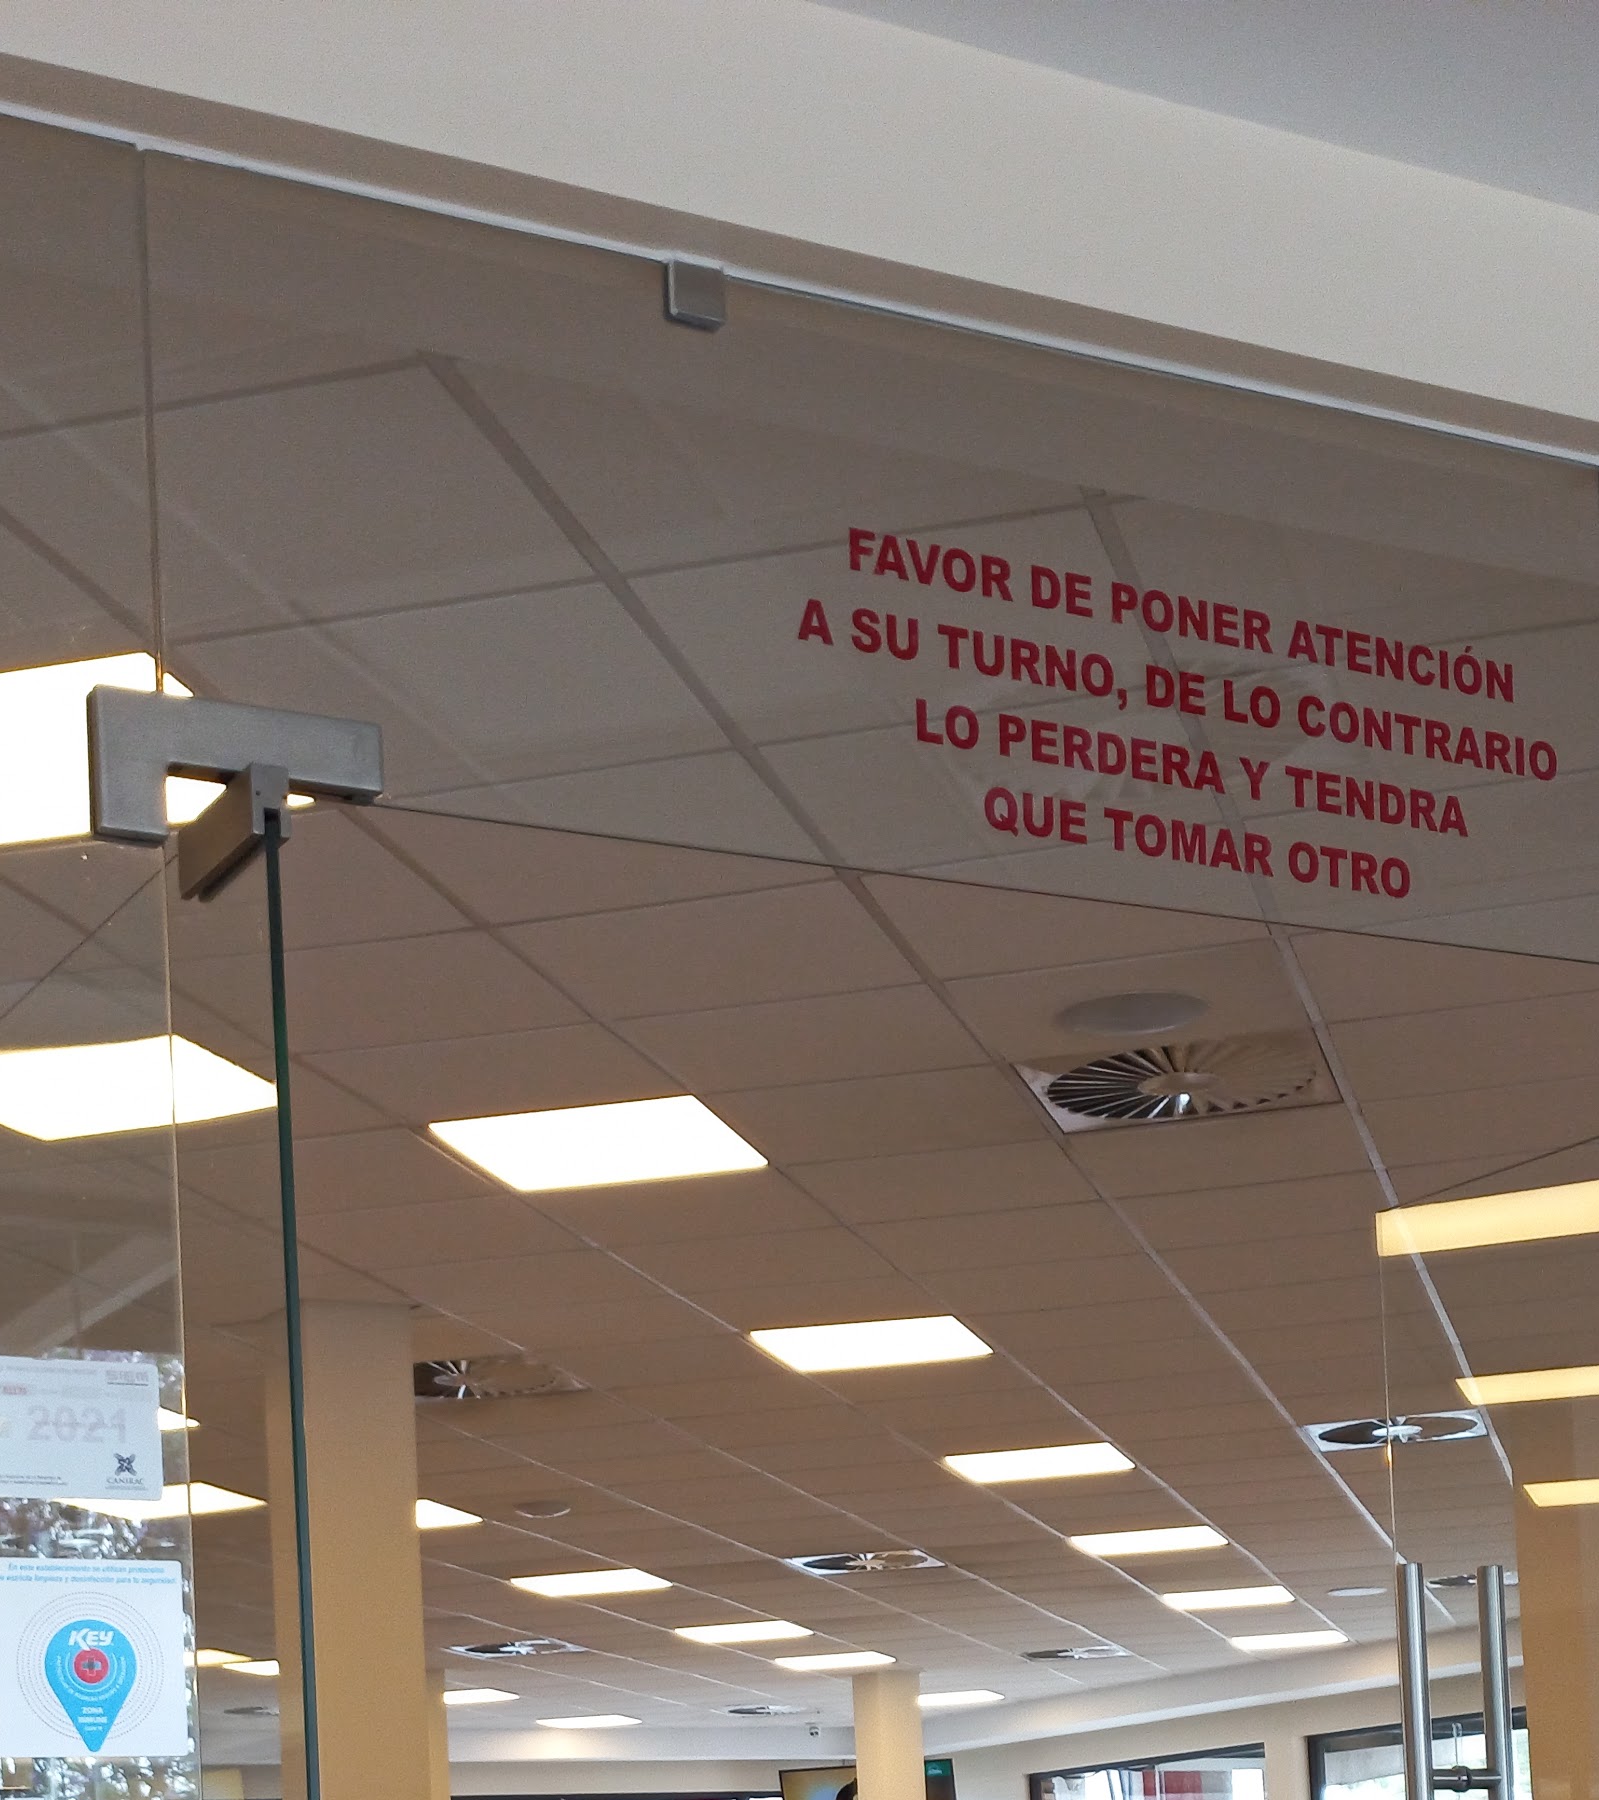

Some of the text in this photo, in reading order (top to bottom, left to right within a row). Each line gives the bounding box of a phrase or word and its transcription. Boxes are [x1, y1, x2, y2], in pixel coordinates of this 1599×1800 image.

[847, 527, 1514, 704] FAVOR DE PONER ATENCIÓN
[798, 599, 1558, 781] A SU TURNO, DE LO CONTRARIO
[914, 699, 1469, 837] LO PERDERA Y TENDRA
[983, 787, 1411, 899] QUE TOMAR OTRO
[27, 1405, 126, 1442] 2021
[68, 1628, 114, 1651] KEY
